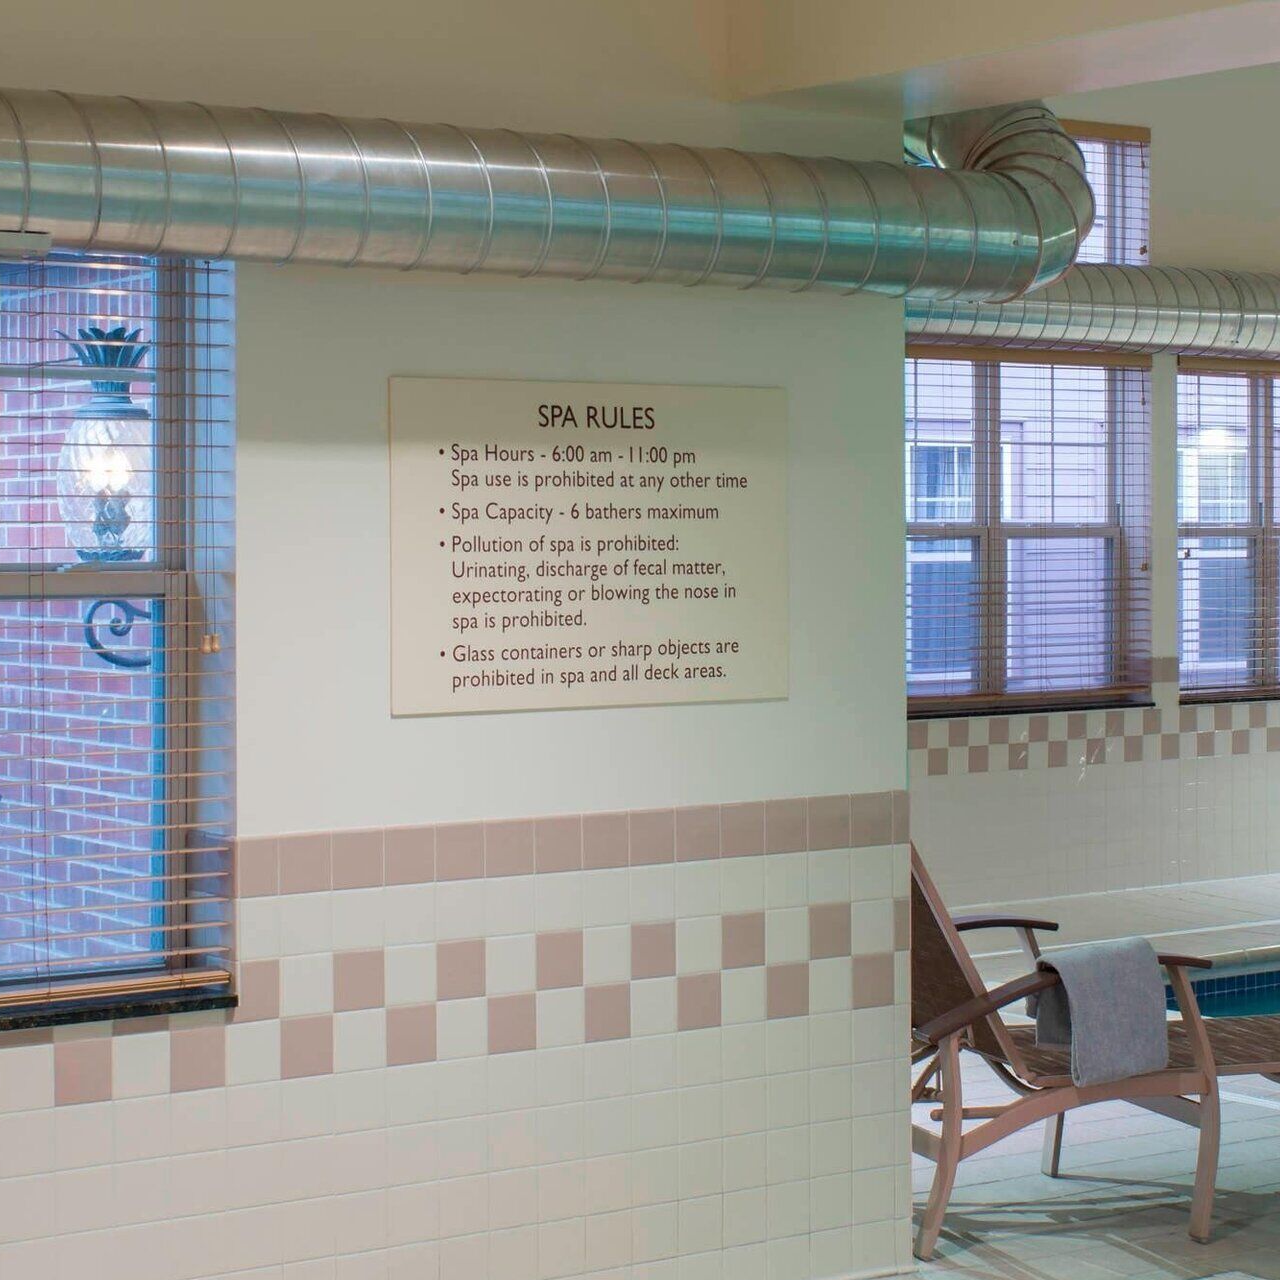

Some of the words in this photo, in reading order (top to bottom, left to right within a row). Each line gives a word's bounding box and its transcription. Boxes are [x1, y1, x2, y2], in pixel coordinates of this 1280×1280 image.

[538, 404, 578, 428] SPA
[586, 405, 655, 430] RULES
[451, 442, 479, 466] Spa
[484, 443, 535, 462] Hours
[551, 444, 585, 463] 6:00
[590, 450, 612, 463] am
[629, 446, 668, 464] 11:00
[673, 451, 696, 469] pm
[451, 468, 479, 492] Spa
[485, 474, 512, 487] use
[517, 470, 529, 487] is
[534, 469, 615, 492] prohibited
[620, 474, 635, 488] at
[639, 475, 665, 493] any
[669, 471, 711, 488] other
[715, 470, 748, 489] time
[451, 501, 479, 525] Spa
[485, 502, 554, 525] Capacity
[570, 502, 580, 520] 6
[585, 502, 642, 520] bathers
[647, 503, 719, 520] maximum
[452, 535, 523, 553] Pollution
[528, 534, 546, 553] of
[549, 539, 575, 557] spa
[580, 535, 592, 552] is
[597, 533, 679, 557] prohibited:
[452, 560, 530, 583] Urinating,
[535, 559, 608, 582] discharge
[613, 558, 630, 576] of
[633, 558, 667, 576] fecal
[672, 562, 726, 577] matter,
[452, 585, 563, 609] expectorating
[567, 589, 586, 602] or
[591, 583, 650, 605] blowing
[654, 583, 679, 600] the
[684, 586, 719, 599] nose
[724, 582, 736, 599] in
[452, 616, 479, 635] spa
[484, 612, 496, 629] is
[502, 609, 587, 633] prohibited.
[452, 644, 495, 663] Glass
[501, 643, 583, 661] containers
[588, 645, 606, 658] or
[611, 639, 653, 661] sharp
[657, 638, 711, 660] objects
[715, 641, 739, 654] are
[452, 667, 535, 694] prohibited
[541, 668, 554, 685] in
[560, 670, 585, 689] spa
[590, 664, 617, 683] and
[622, 663, 639, 682] all
[644, 662, 680, 681] deck
[684, 666, 727, 679] areas.
